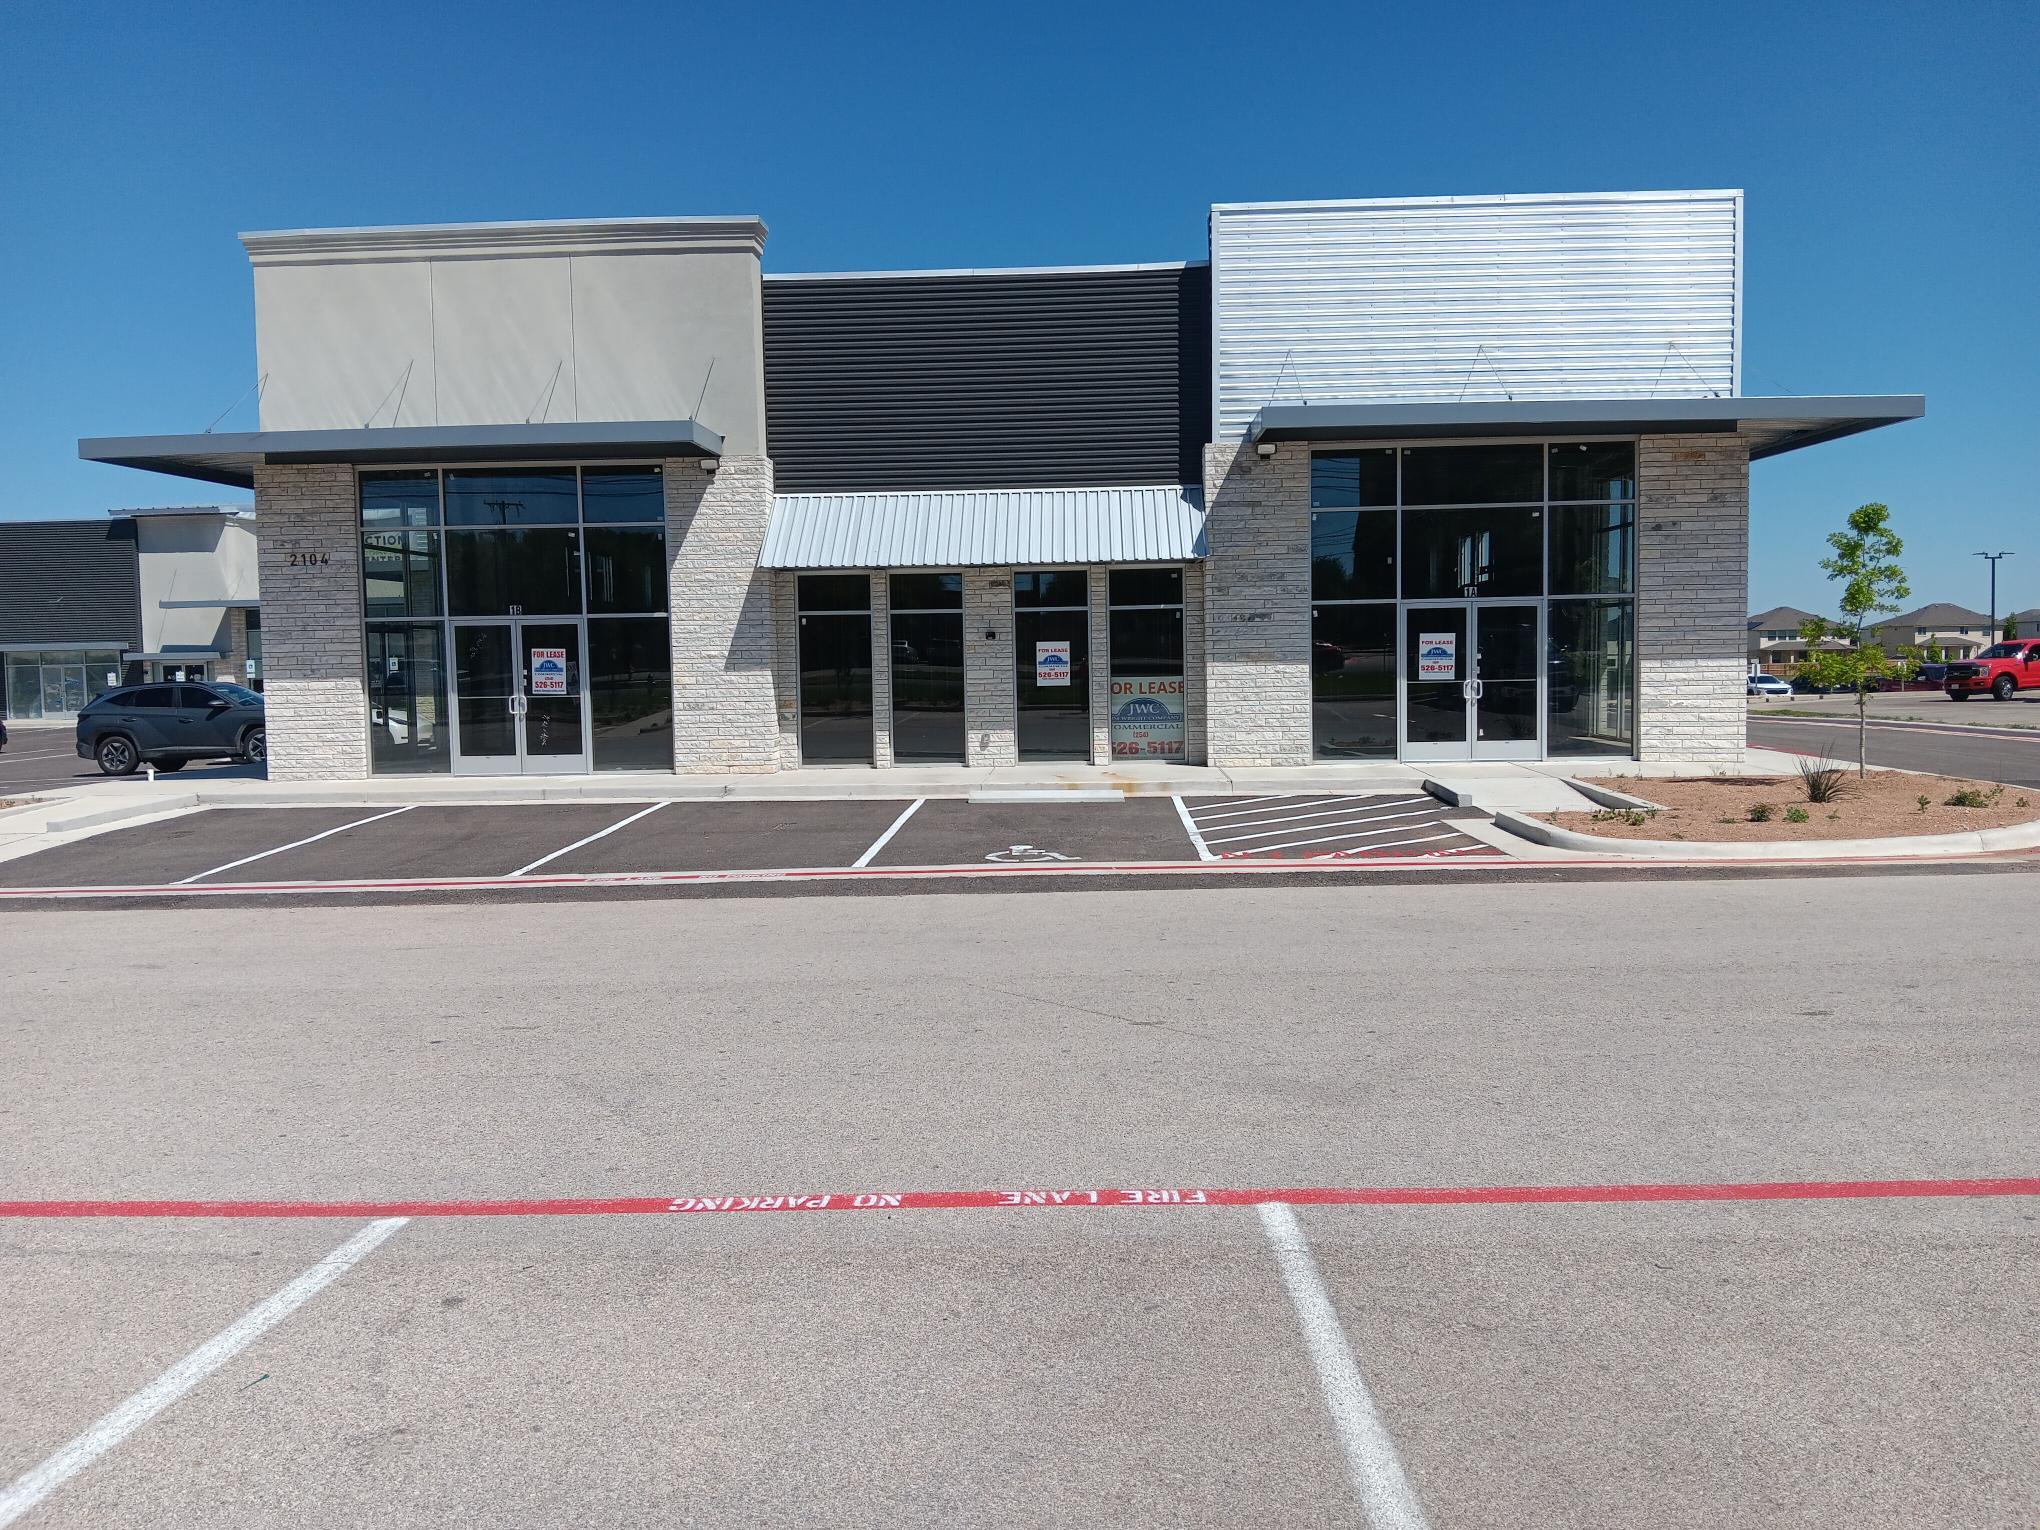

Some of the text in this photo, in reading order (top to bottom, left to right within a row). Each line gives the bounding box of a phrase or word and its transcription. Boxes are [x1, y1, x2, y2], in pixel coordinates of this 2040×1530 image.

[290, 553, 329, 566] 2104
[1465, 587, 1477, 597] 1A
[533, 650, 565, 659] FOR LEASE
[535, 681, 564, 689] 526-5117
[1111, 681, 1184, 695] OR LEASE
[1127, 703, 1160, 716] JWC
[668, 1190, 1207, 1211] FIRE LANE NO PARKING
